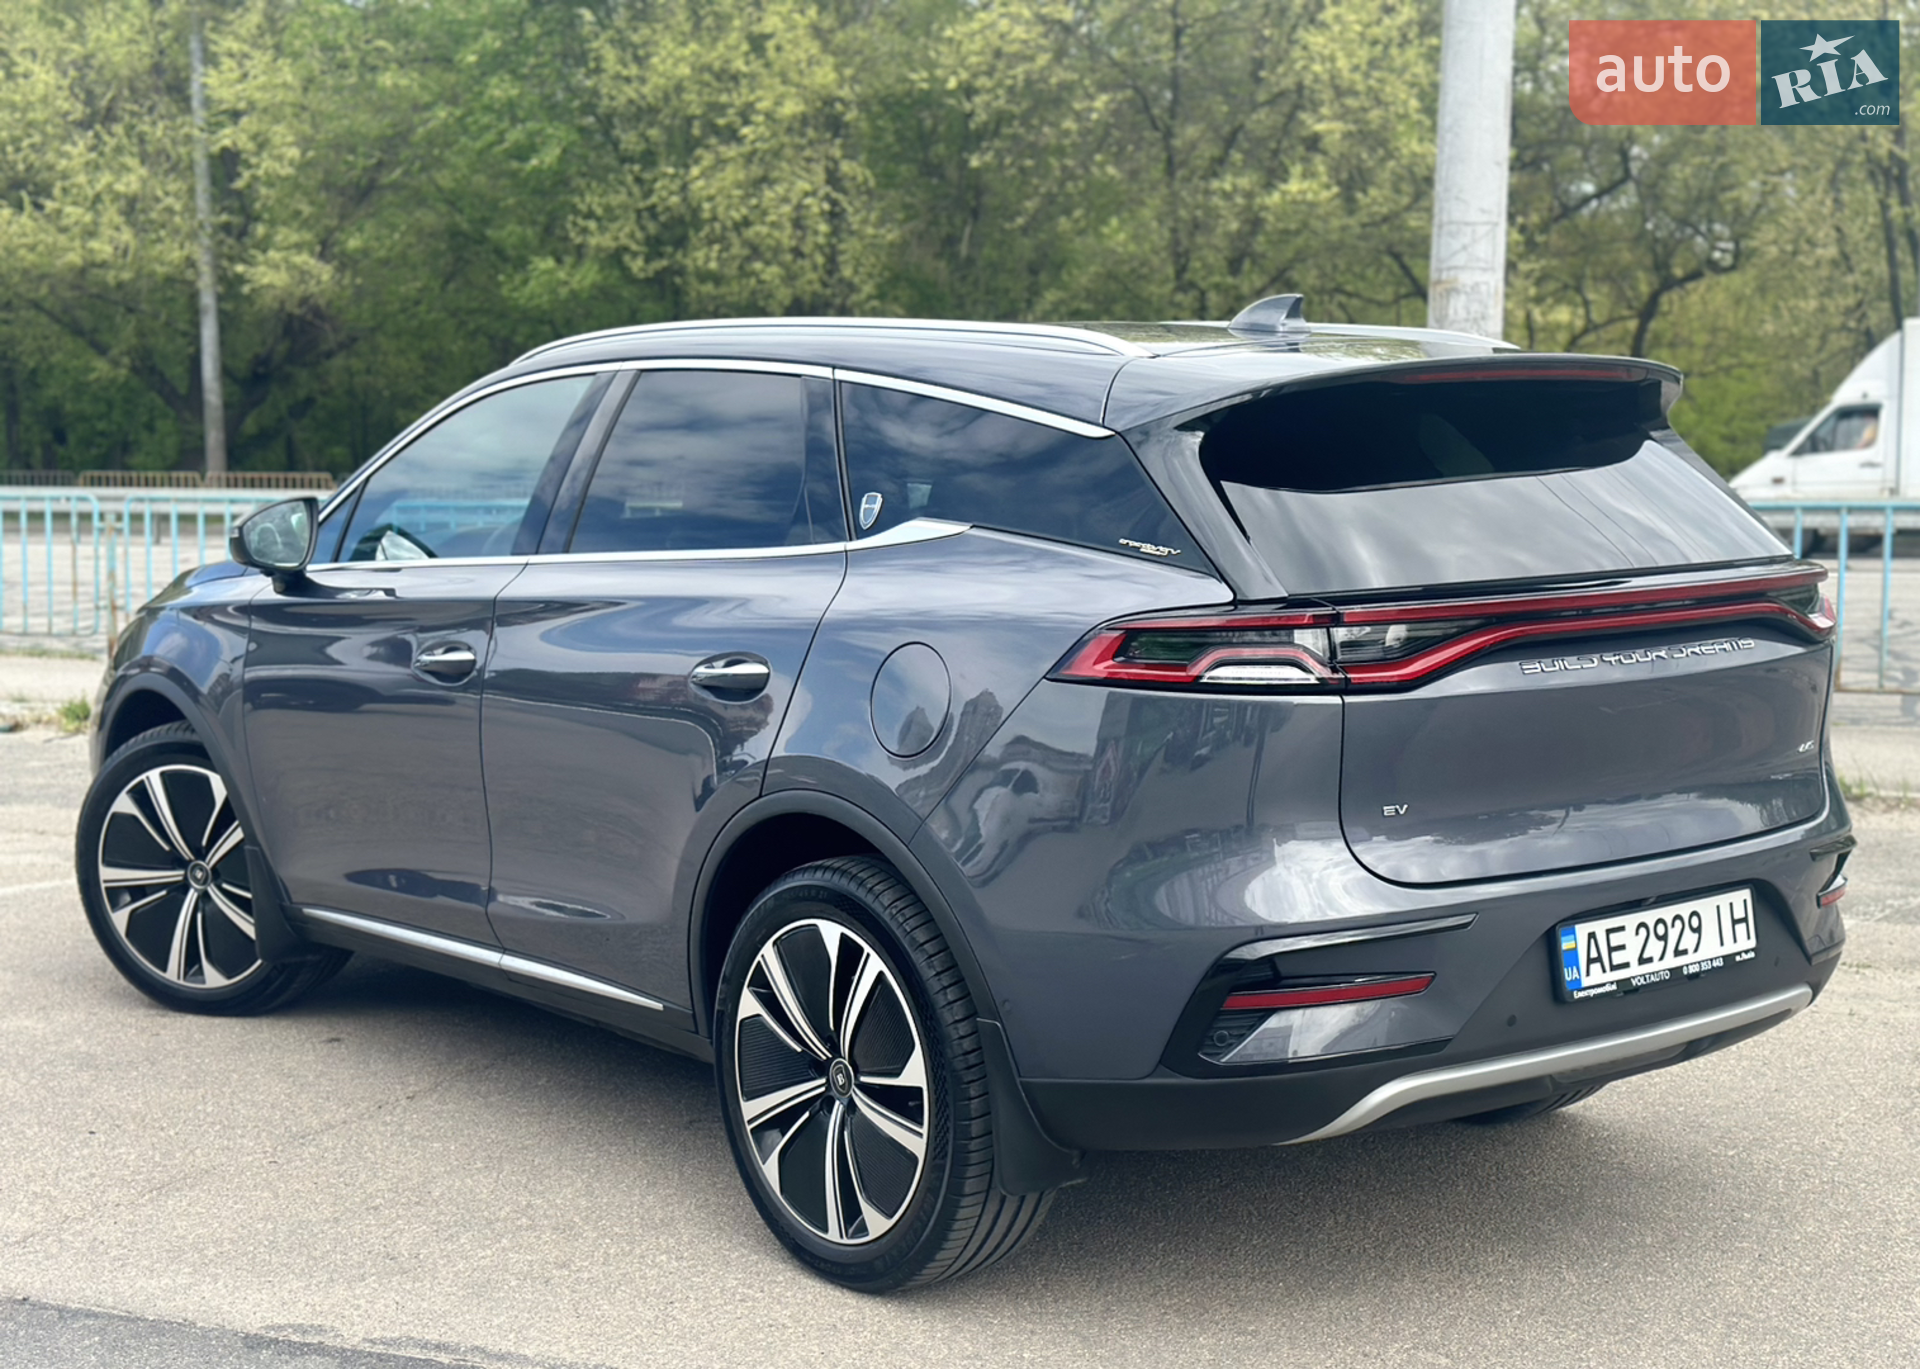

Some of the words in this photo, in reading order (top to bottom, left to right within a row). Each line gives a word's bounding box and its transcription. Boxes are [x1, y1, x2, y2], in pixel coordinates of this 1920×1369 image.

[1521, 656, 1598, 674] BUILD
[1602, 649, 1668, 665] YOUR
[1672, 638, 1755, 659] DREAMS
[1383, 803, 1409, 816] EV
[1585, 925, 1630, 977] AE
[1635, 910, 1702, 966] 2929
[1716, 898, 1751, 947] IH
[1564, 965, 1580, 981] UA
[1682, 965, 1688, 975] 0
[1701, 960, 1712, 971] 353
[1631, 970, 1670, 986] VOLTAUTO
